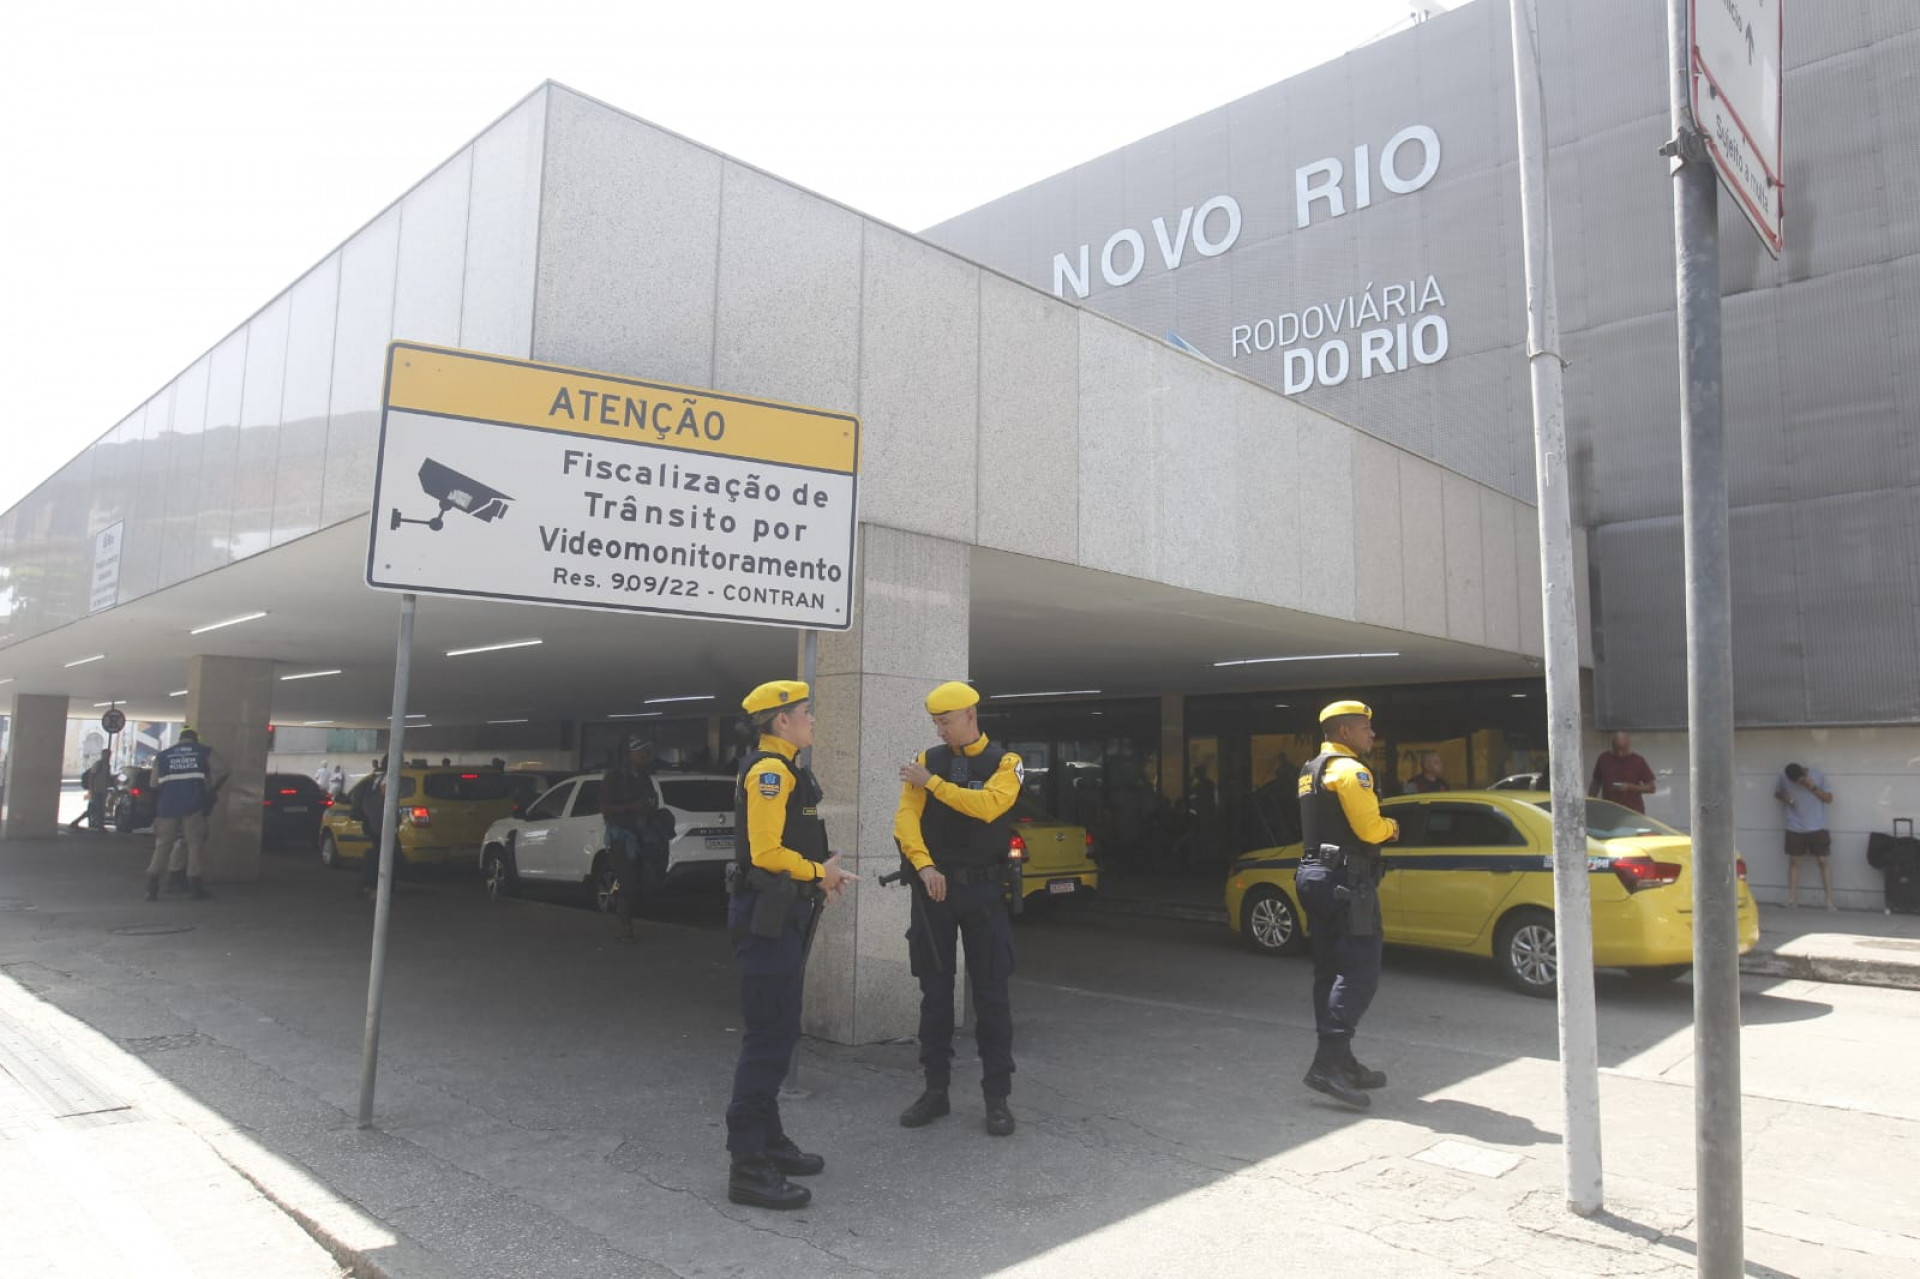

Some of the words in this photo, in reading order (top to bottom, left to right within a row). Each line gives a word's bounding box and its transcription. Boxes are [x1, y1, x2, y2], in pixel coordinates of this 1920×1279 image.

[1716, 112, 1743, 172] Sujeito
[1750, 172, 1769, 215] multa
[1053, 194, 1243, 299] NOVO
[1295, 124, 1441, 229] RIO
[1231, 274, 1446, 358] RODOVIÁRIA
[1283, 339, 1350, 396] DO
[1361, 314, 1449, 379] RIO
[549, 386, 726, 441] ATENÇÃO
[563, 449, 781, 503] Fiscalização
[793, 484, 829, 508] de
[585, 491, 736, 534] Trânsito
[753, 519, 807, 543] por
[539, 525, 843, 584] Videomonitoramento
[553, 567, 601, 589] Res.
[723, 584, 825, 610] CONTRAN
